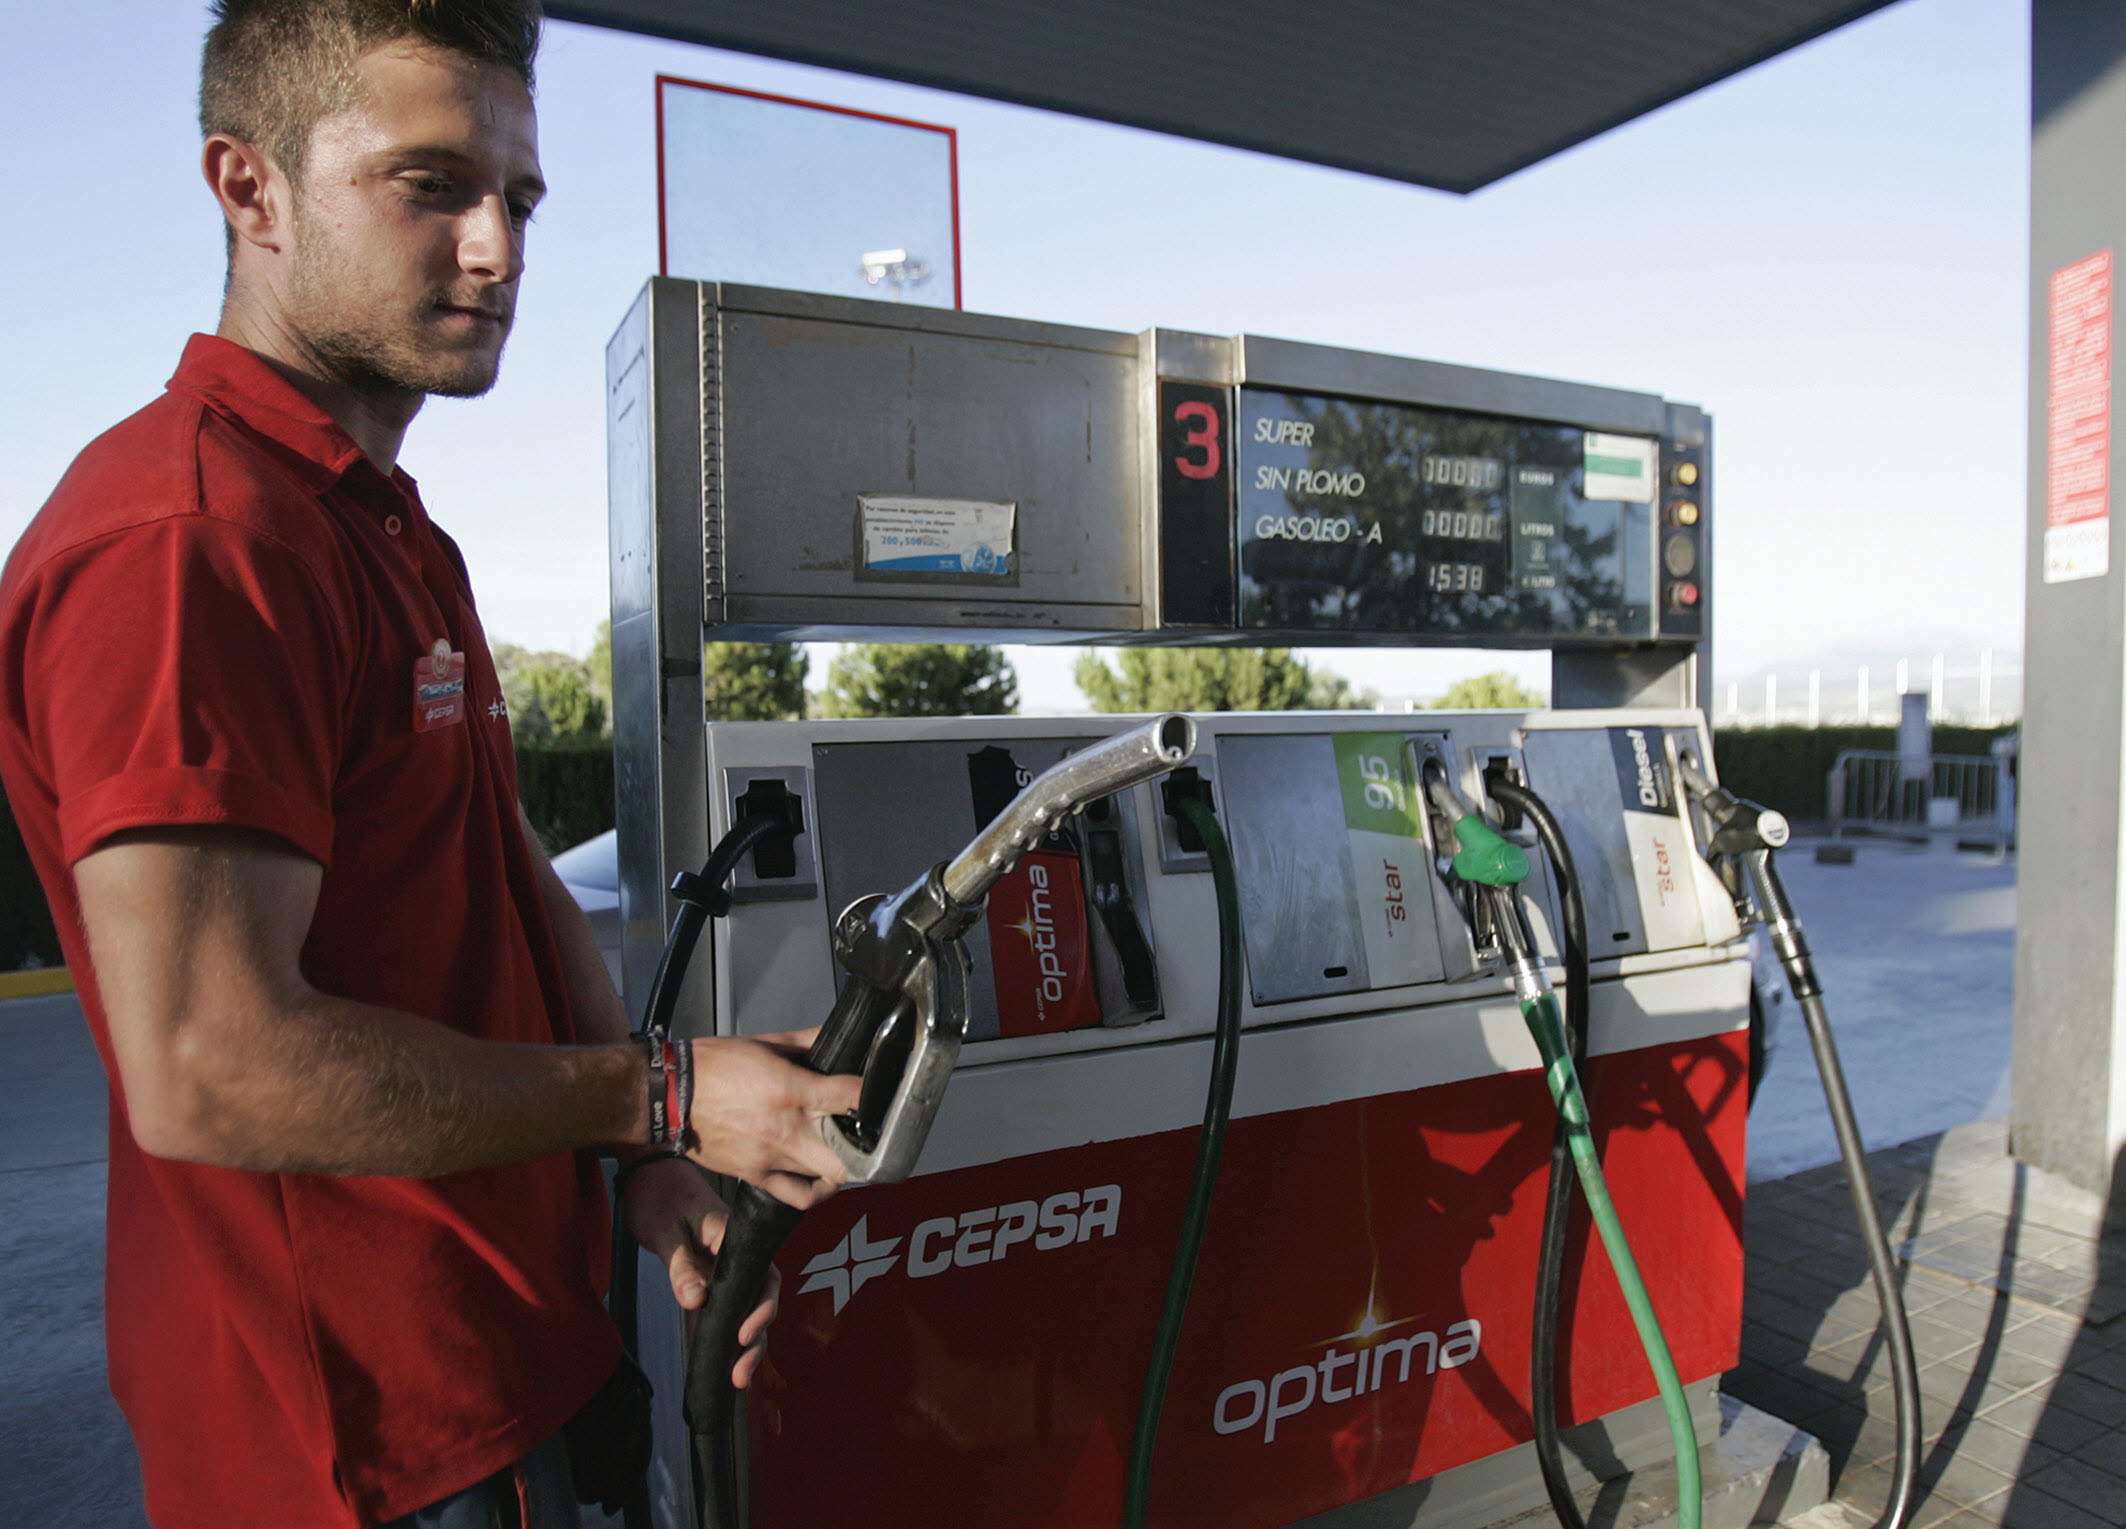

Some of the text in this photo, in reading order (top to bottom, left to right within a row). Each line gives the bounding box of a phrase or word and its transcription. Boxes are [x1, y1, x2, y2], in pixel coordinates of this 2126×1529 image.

[1174, 401, 1220, 480] 3
[1255, 417, 1315, 448] SUPER
[1255, 464, 1366, 498] SIN PLOMO
[1255, 515, 1351, 544] GASOLEO
[1366, 522, 1383, 545] A
[1361, 755, 1394, 810] 95
[1626, 728, 1659, 807] Diesel
[1382, 859, 1406, 921] star
[1654, 837, 1674, 893] star
[1029, 864, 1068, 1002] optima
[907, 1184, 1122, 1278] CEPSA
[1213, 1318, 1482, 1443] optima
